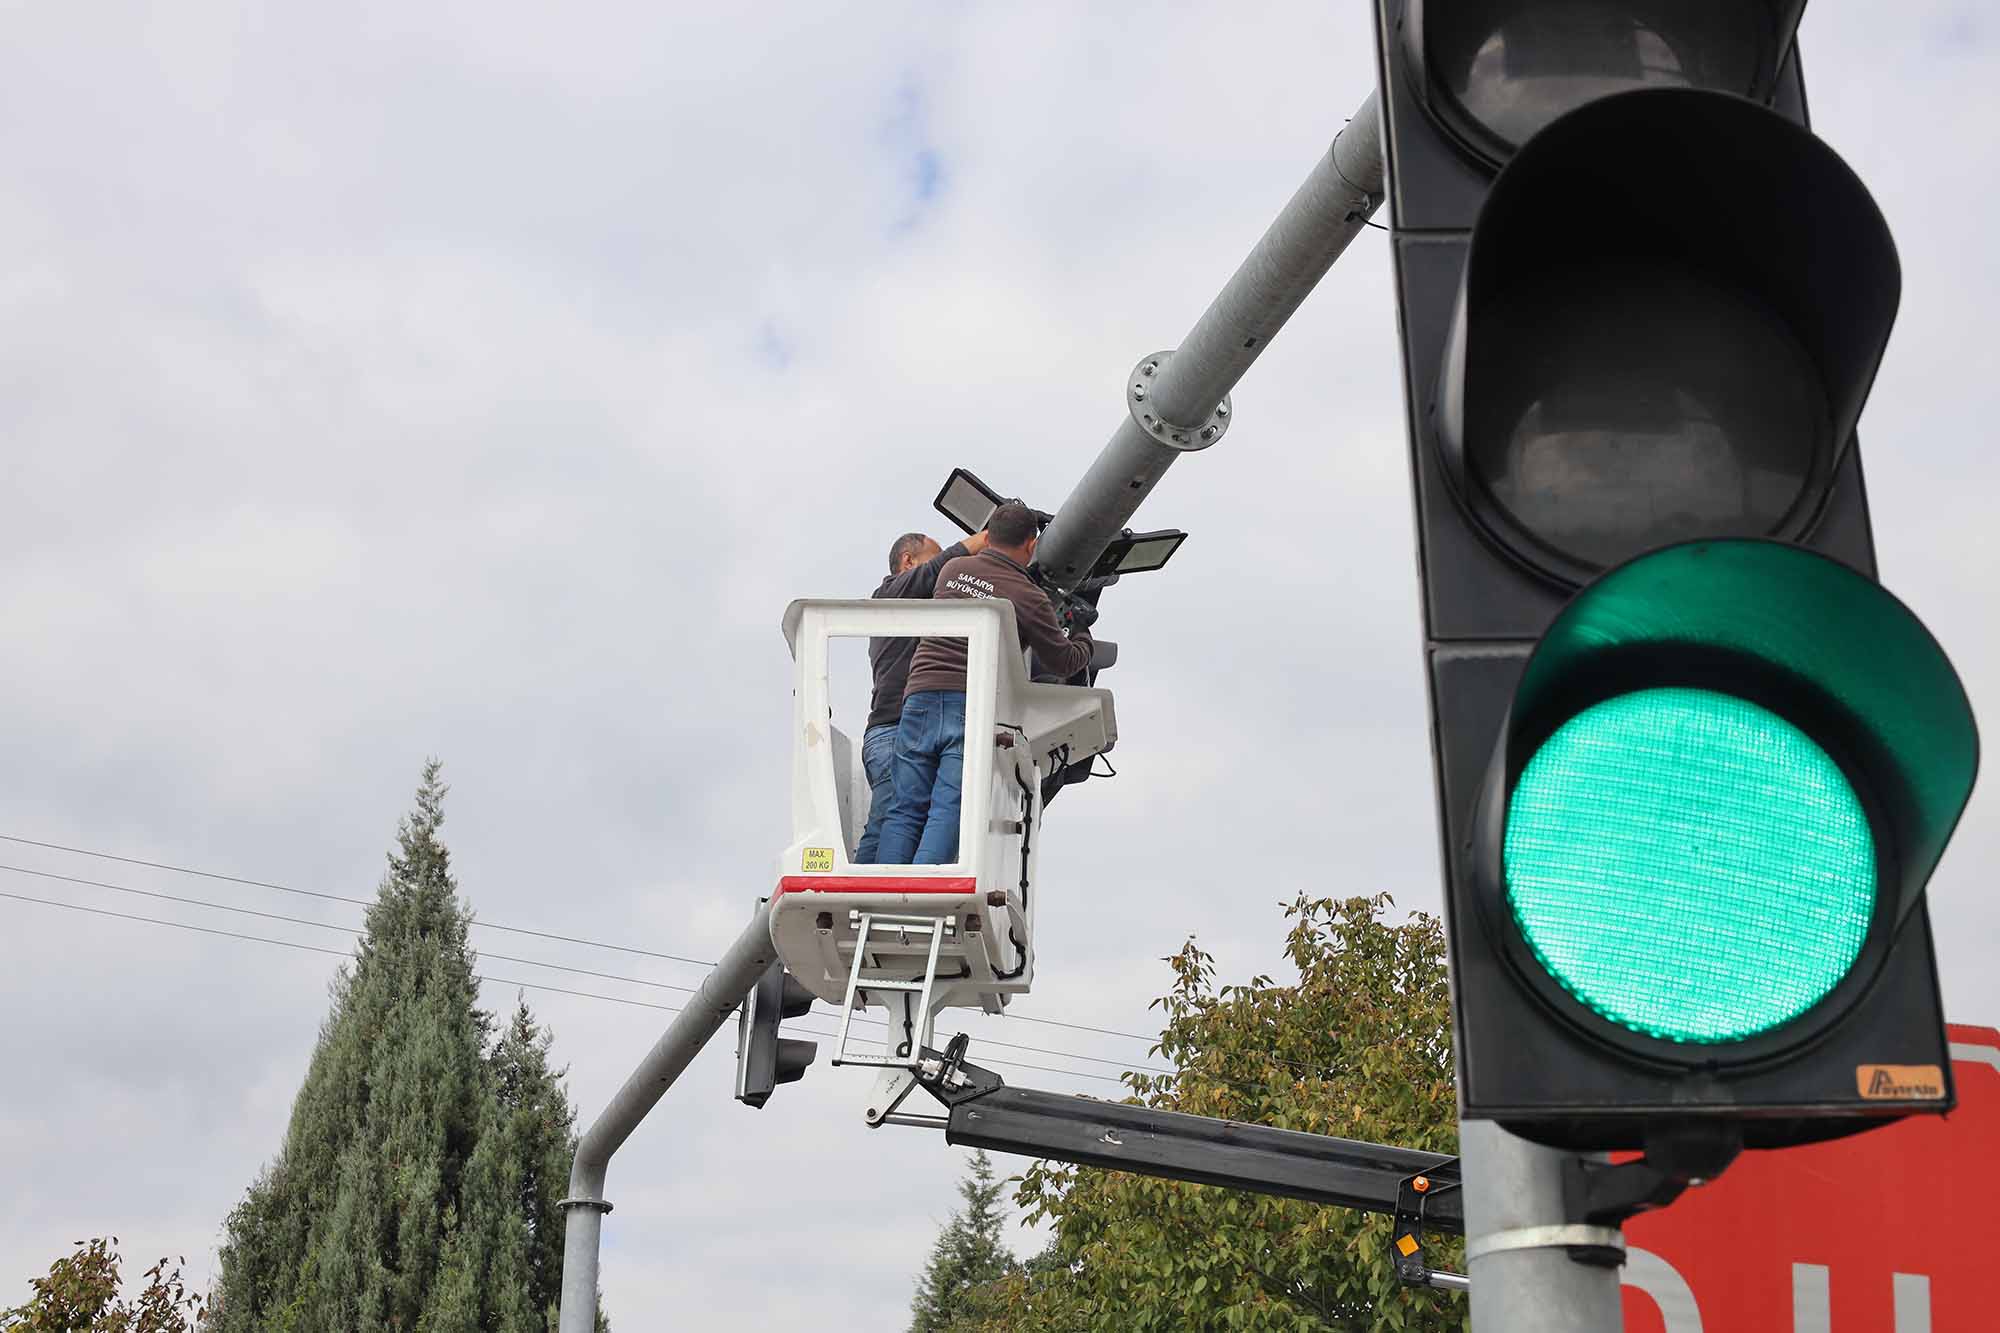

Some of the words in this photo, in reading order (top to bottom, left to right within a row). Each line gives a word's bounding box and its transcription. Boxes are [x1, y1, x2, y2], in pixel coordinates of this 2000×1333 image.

[958, 573, 994, 592] SAKARYA
[806, 861, 818, 869] 200
[819, 861, 829, 869] KG
